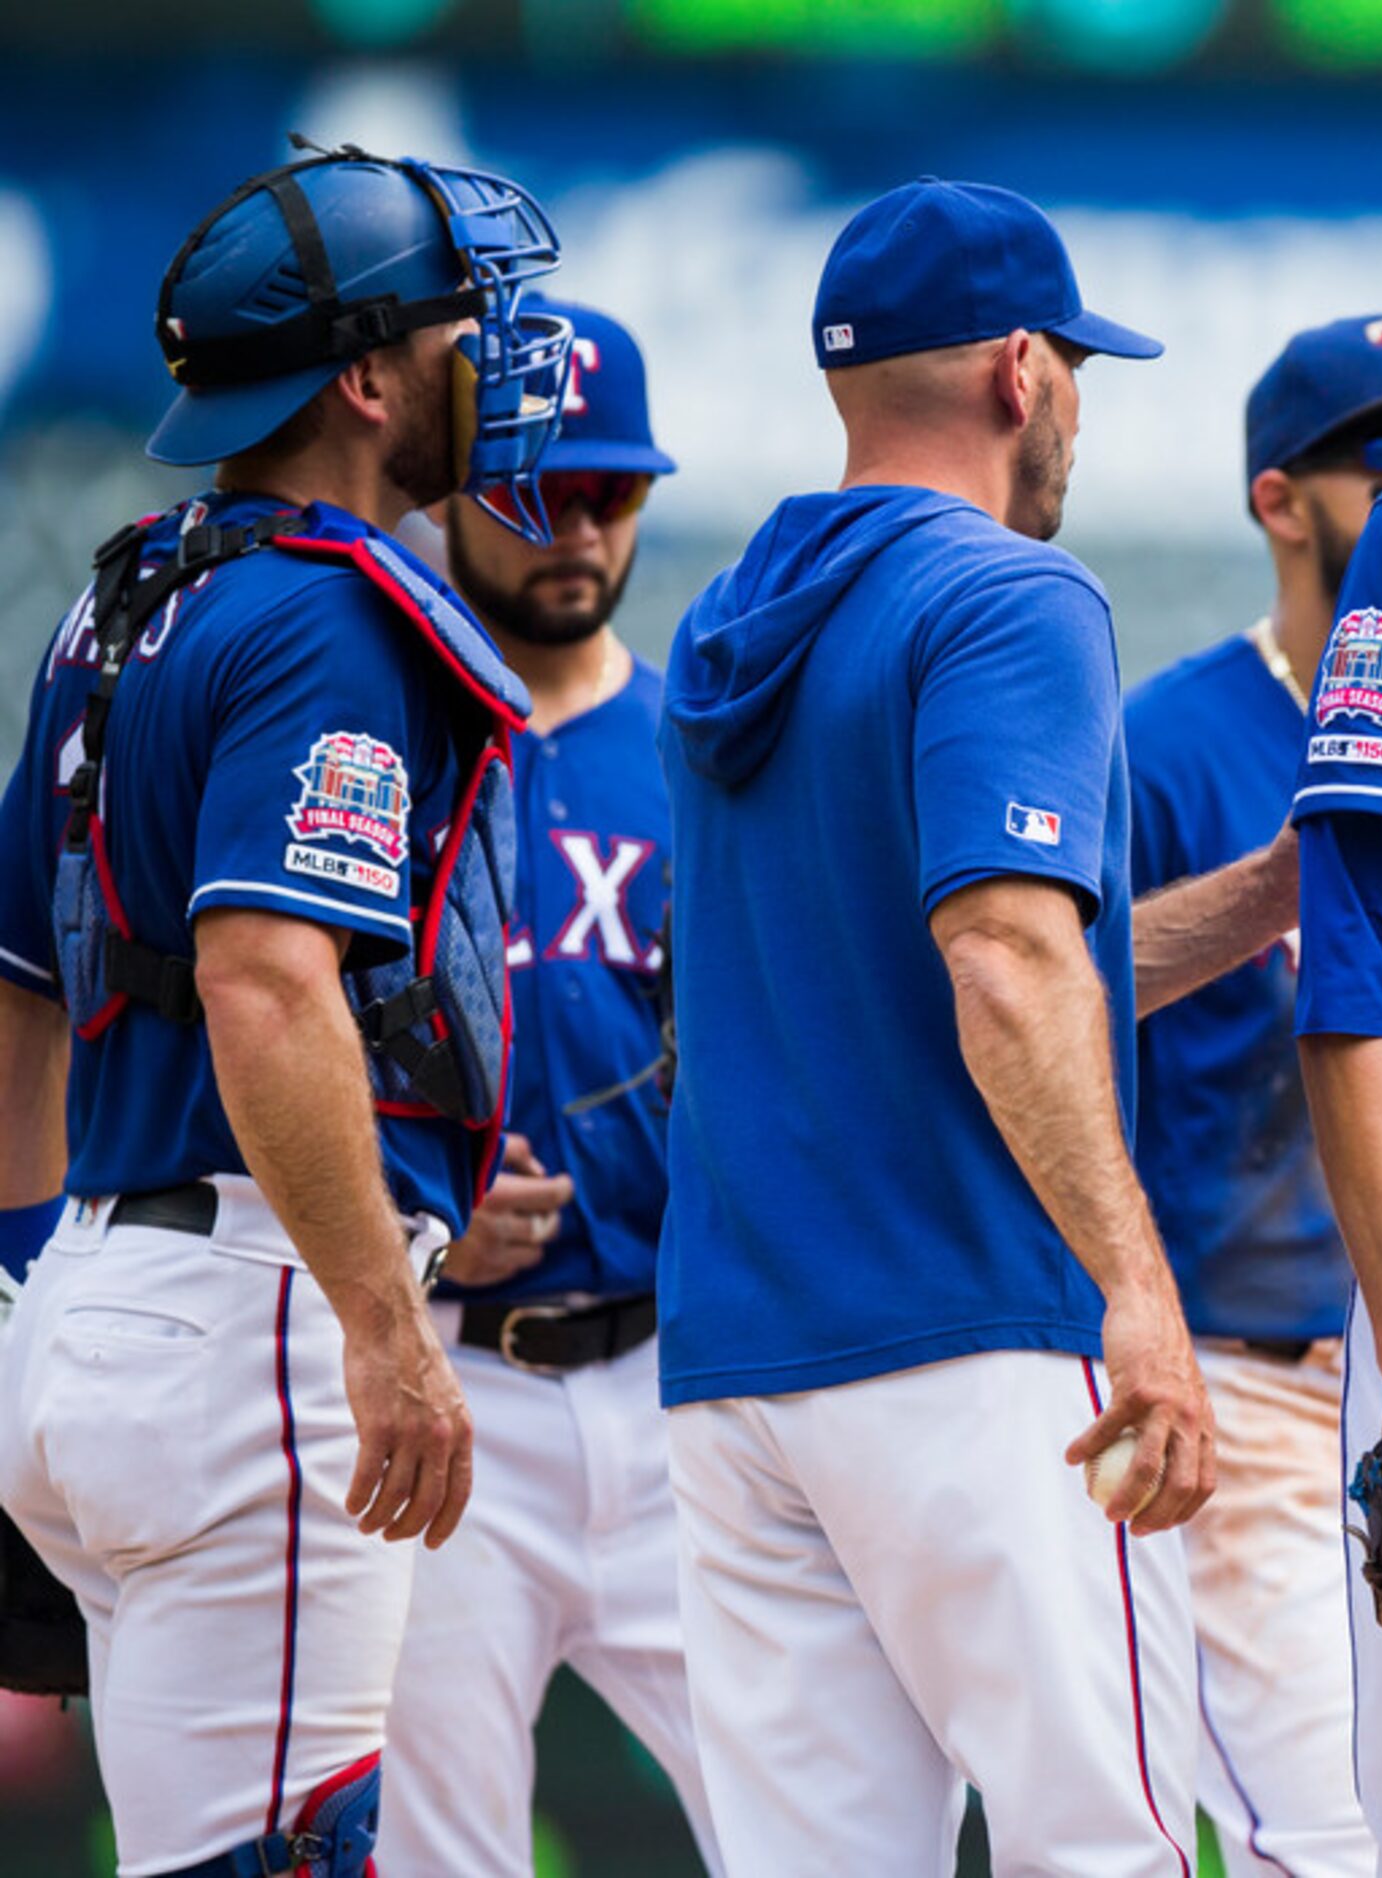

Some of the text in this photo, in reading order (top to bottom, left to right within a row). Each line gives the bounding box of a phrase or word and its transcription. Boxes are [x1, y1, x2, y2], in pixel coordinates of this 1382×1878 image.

[306, 809, 396, 847] FINAL SEASON
[292, 849, 336, 873] MLB
